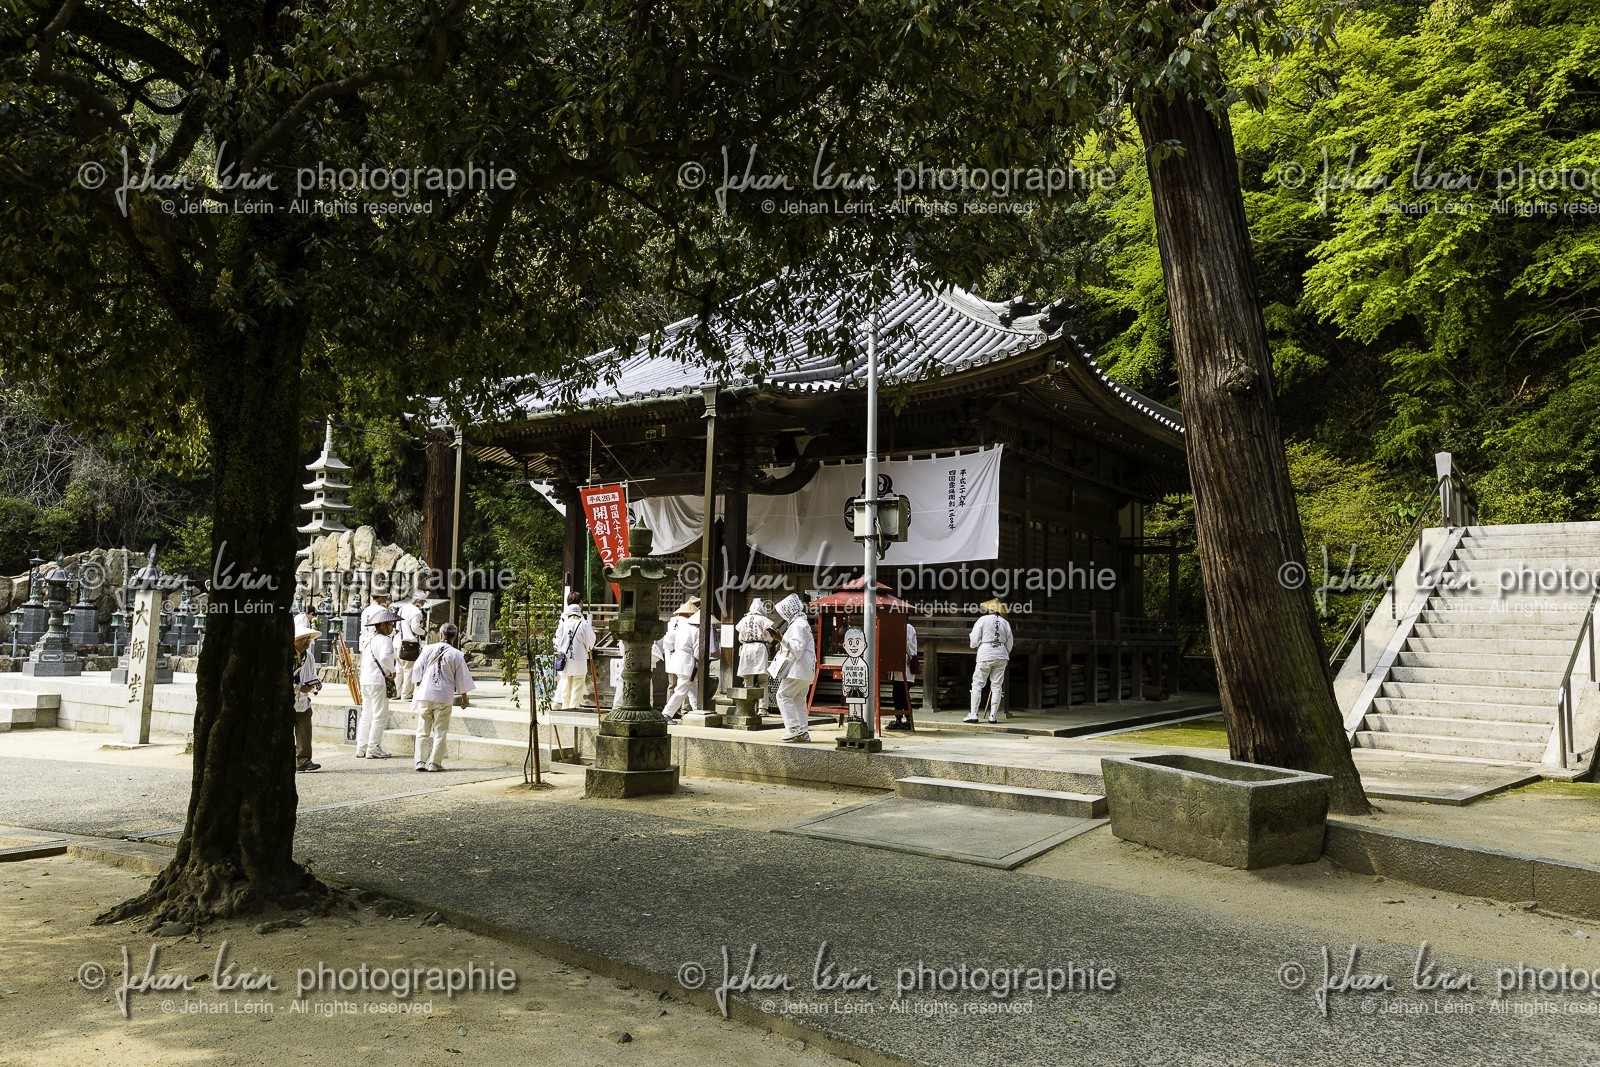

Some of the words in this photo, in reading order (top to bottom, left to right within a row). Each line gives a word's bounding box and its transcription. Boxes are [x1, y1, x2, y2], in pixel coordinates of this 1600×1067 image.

[588, 493, 618, 503] 平成26年
[128, 600, 149, 704] 大師堂
